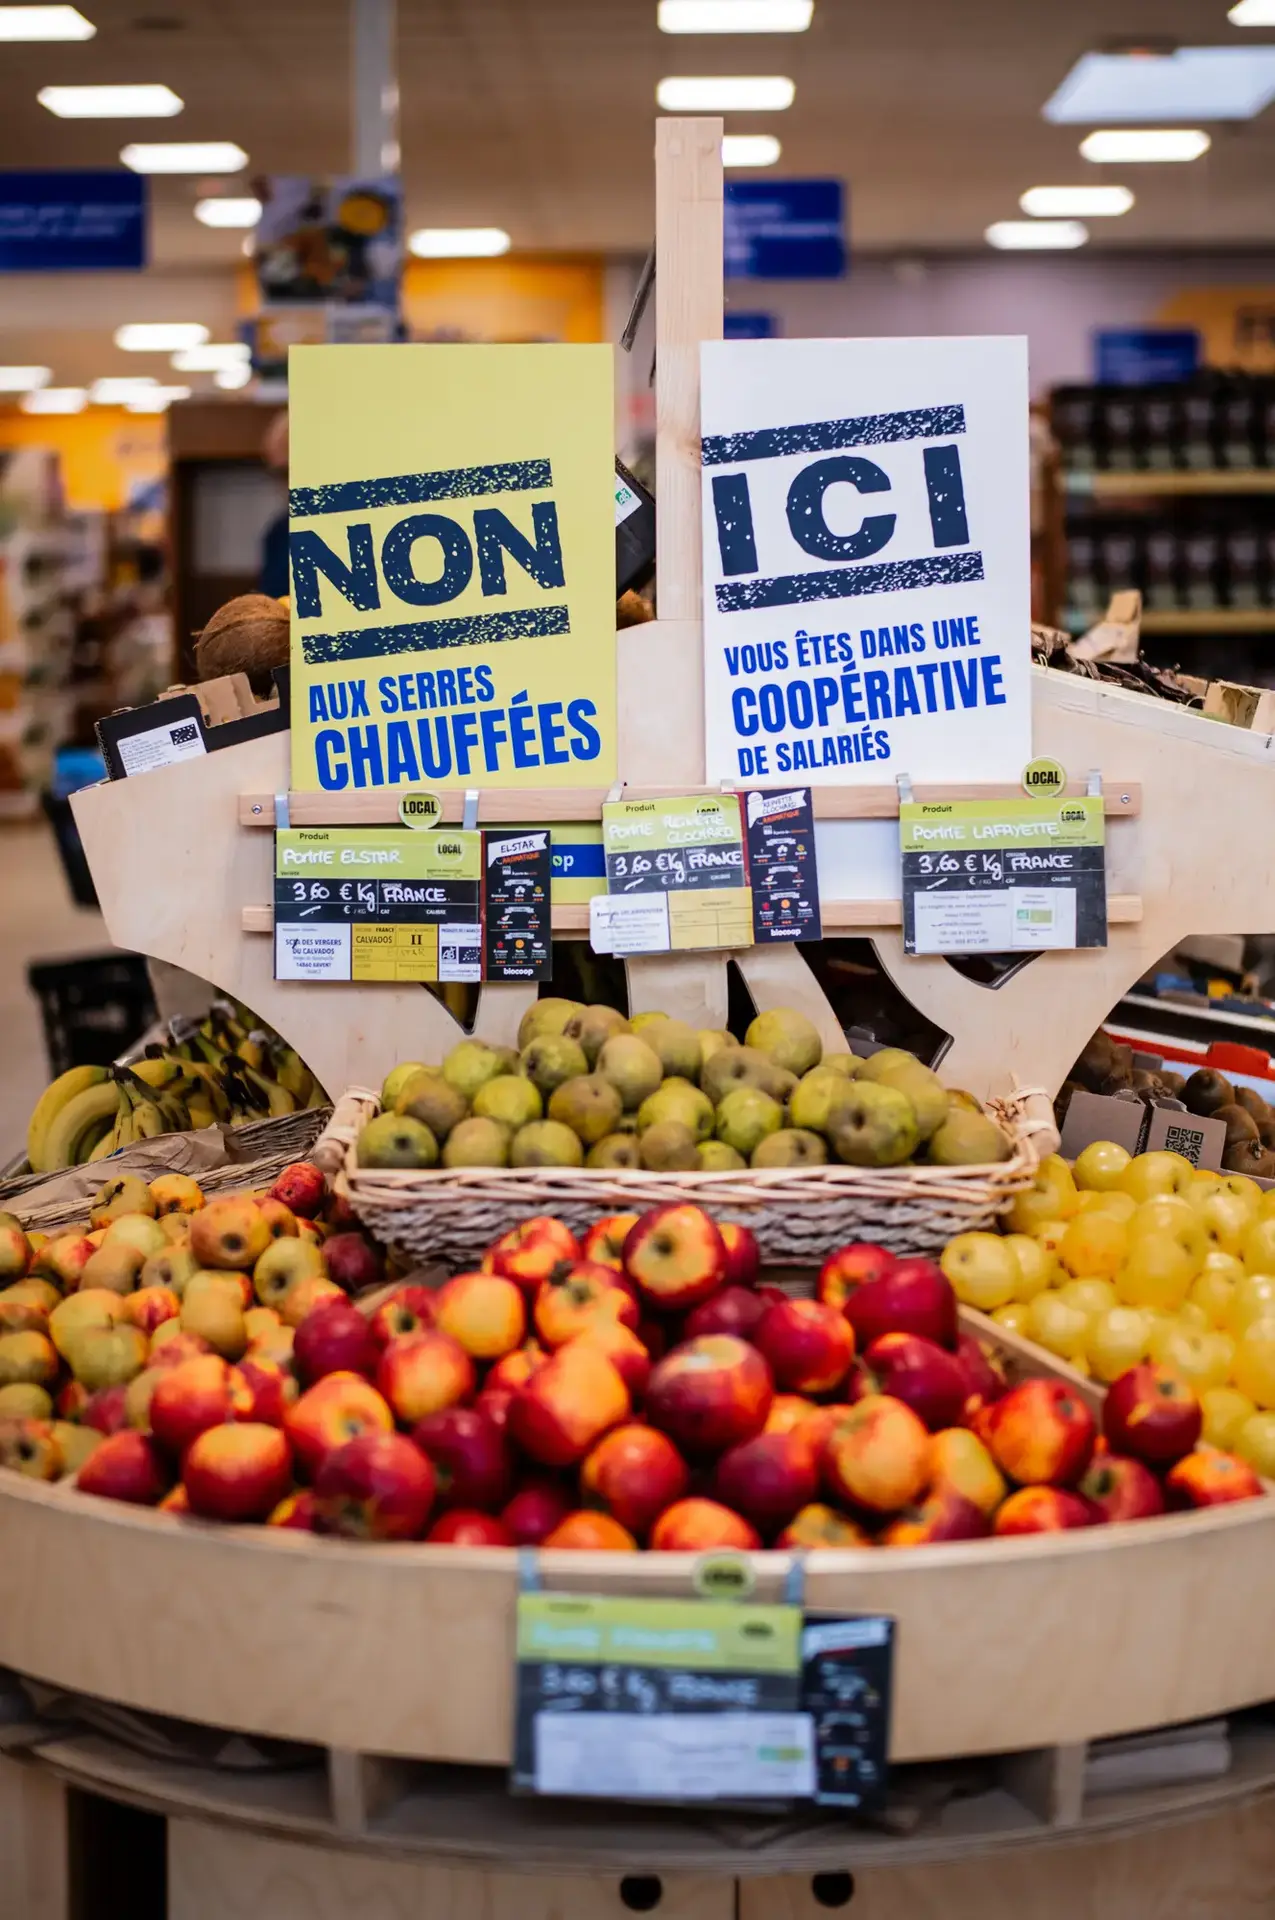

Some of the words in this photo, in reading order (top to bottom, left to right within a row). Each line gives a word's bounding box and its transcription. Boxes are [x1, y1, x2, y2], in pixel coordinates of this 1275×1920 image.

[711, 444, 970, 577] ICI
[289, 501, 566, 619] NON
[724, 640, 789, 676] VOUS
[795, 630, 853, 667] ÊTES
[860, 623, 926, 659] DANS
[933, 616, 981, 650] UNE
[309, 680, 370, 723] AUX
[378, 664, 495, 714] SERRES
[731, 655, 1007, 737] COOPÉRATIVE
[314, 689, 601, 790] CHAUFFÉES
[737, 745, 769, 777] DE
[776, 725, 891, 772] SALARIÉS
[1026, 771, 1061, 786] LOCAL
[402, 801, 438, 814] LOCAL
[625, 803, 656, 813] Produit
[922, 805, 953, 814] Produit
[1061, 810, 1086, 822] LOCAL
[973, 822, 1060, 841] LAFAYETTE
[438, 844, 462, 854] LOCAL
[500, 840, 536, 854] ELSTAR
[340, 848, 404, 865] ELSTAR
[689, 851, 743, 870] FRANCE
[1011, 855, 1074, 872] FRANCE
[383, 887, 448, 903] FRANCE
[355, 936, 393, 944] CALVADOS
[411, 934, 423, 945] II
[770, 928, 801, 937] biocoop
[503, 967, 534, 976] biocoop
